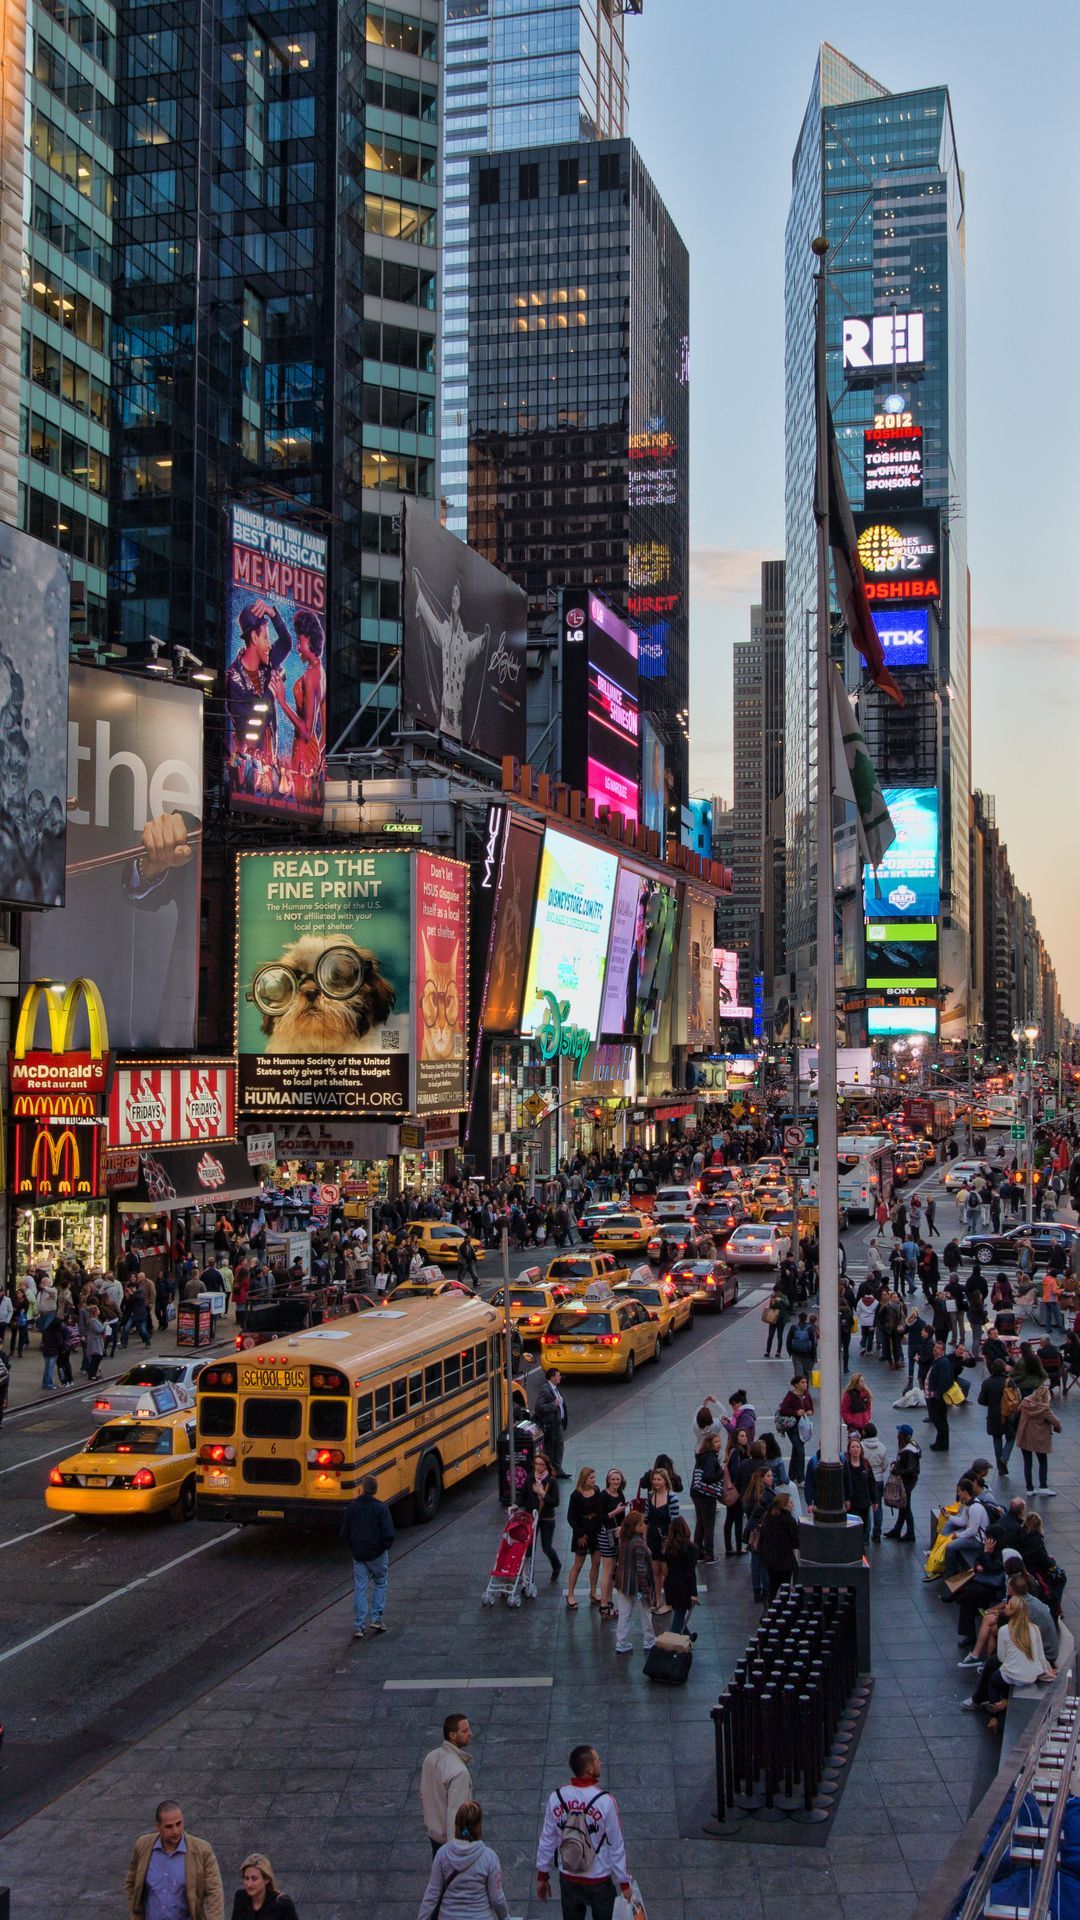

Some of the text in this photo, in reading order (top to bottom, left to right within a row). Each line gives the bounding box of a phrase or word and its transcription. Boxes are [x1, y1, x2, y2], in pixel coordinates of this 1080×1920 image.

[875, 413, 912, 429] 2012
[865, 427, 922, 441] TOSHIBA
[866, 451, 921, 464] TOSHIBA
[877, 465, 921, 475] OFFICIAL
[866, 479, 911, 490] SPONSOR
[265, 520, 283, 538] 2010
[233, 522, 267, 549] BEST
[271, 537, 325, 570] MUSICAL
[234, 547, 324, 609] MEMPHIS
[865, 580, 938, 599] OSHIBA
[567, 630, 584, 642] LG
[878, 630, 923, 646] TDK
[273, 859, 376, 878] READ THE
[431, 864, 446, 880] Don't
[267, 880, 382, 900] FINE PRINT
[423, 881, 459, 903] HSUS disguise
[266, 902, 383, 912] The Humane Society of the U.S.
[422, 901, 436, 916] itself
[437, 908, 444, 918] as
[448, 906, 460, 921] local
[276, 912, 373, 922] is NOT affiliated with your
[294, 923, 354, 932] local pet shelter.
[427, 924, 456, 939] pet shelter.
[256, 1057, 390, 1067] The Humane Society of the United
[13, 1064, 103, 1078] McDonald's
[256, 1068, 390, 1077] States only gives 1% of its budget
[27, 1080, 88, 1088] Restaurant
[294, 1078, 312, 1086] local
[314, 1079, 327, 1087] pet
[329, 1078, 363, 1086] shelters.
[245, 1091, 403, 1106] HUMANEWATCH.ORG
[244, 1370, 305, 1387] SCHOOL BUS
